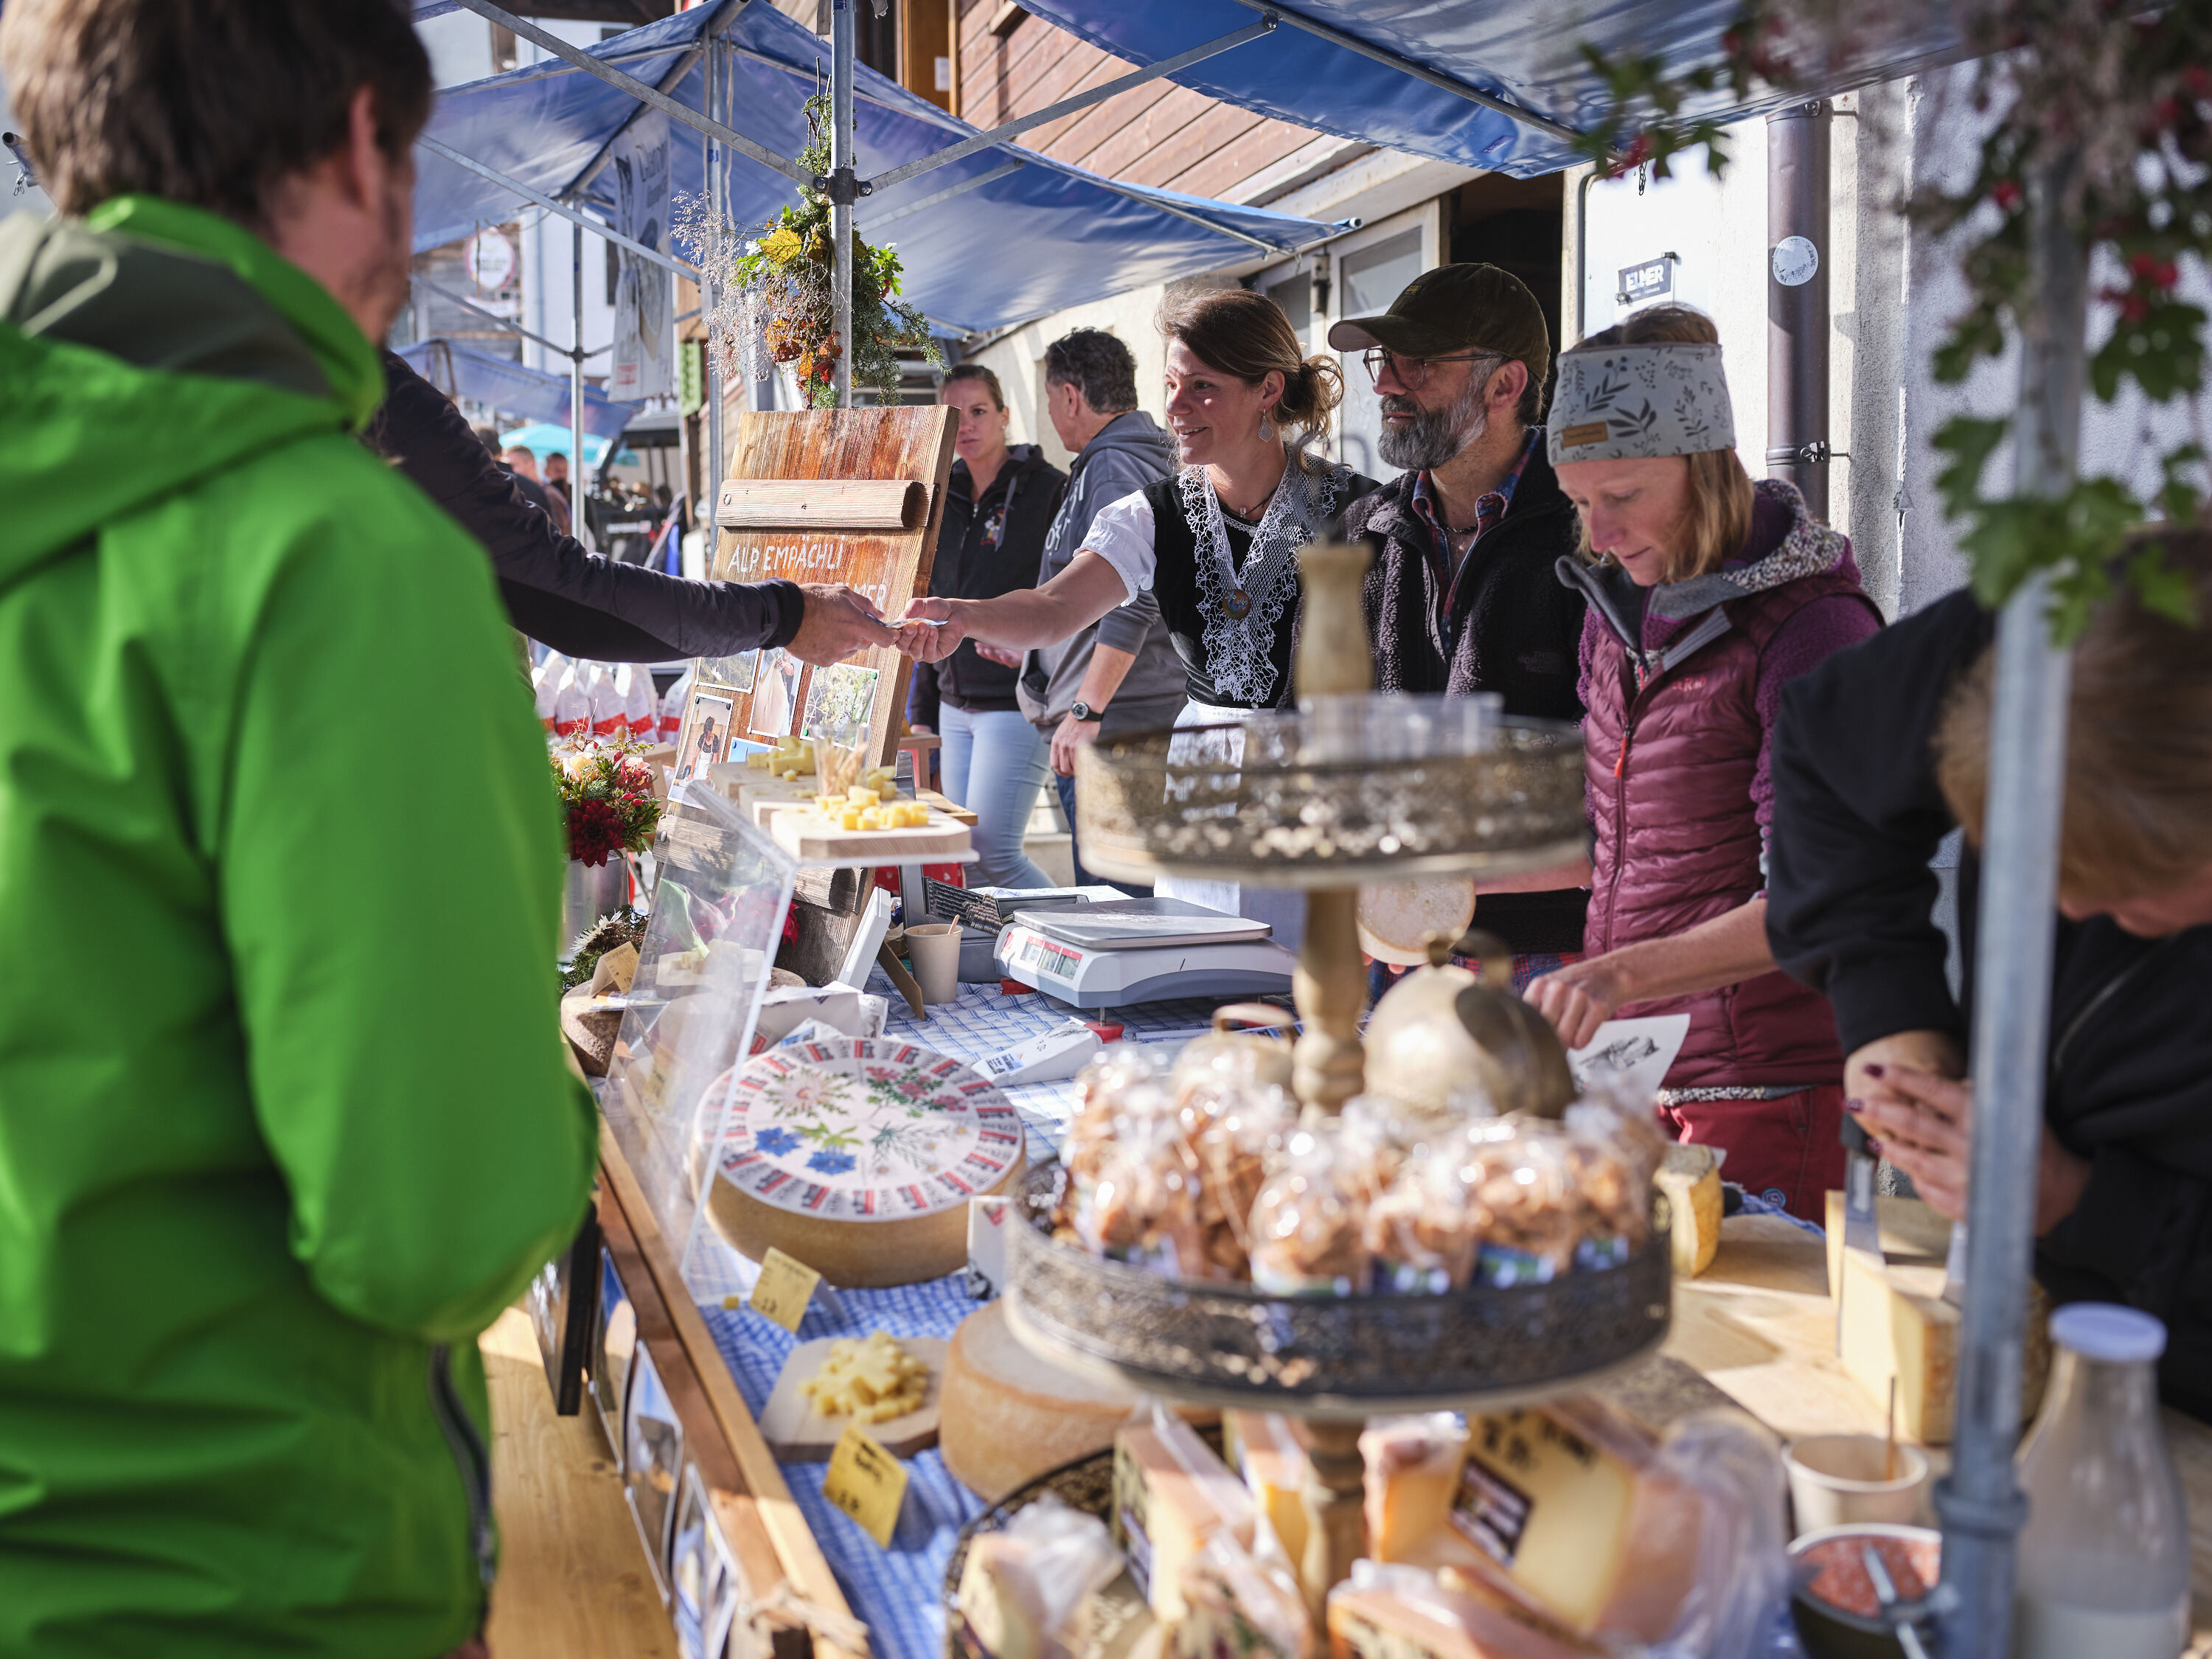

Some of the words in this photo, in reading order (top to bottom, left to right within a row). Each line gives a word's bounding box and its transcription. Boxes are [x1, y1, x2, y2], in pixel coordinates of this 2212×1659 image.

[1626, 264, 1664, 292] ELMER
[727, 544, 759, 573] ALP
[763, 535, 846, 571] EMPÄCHLI
